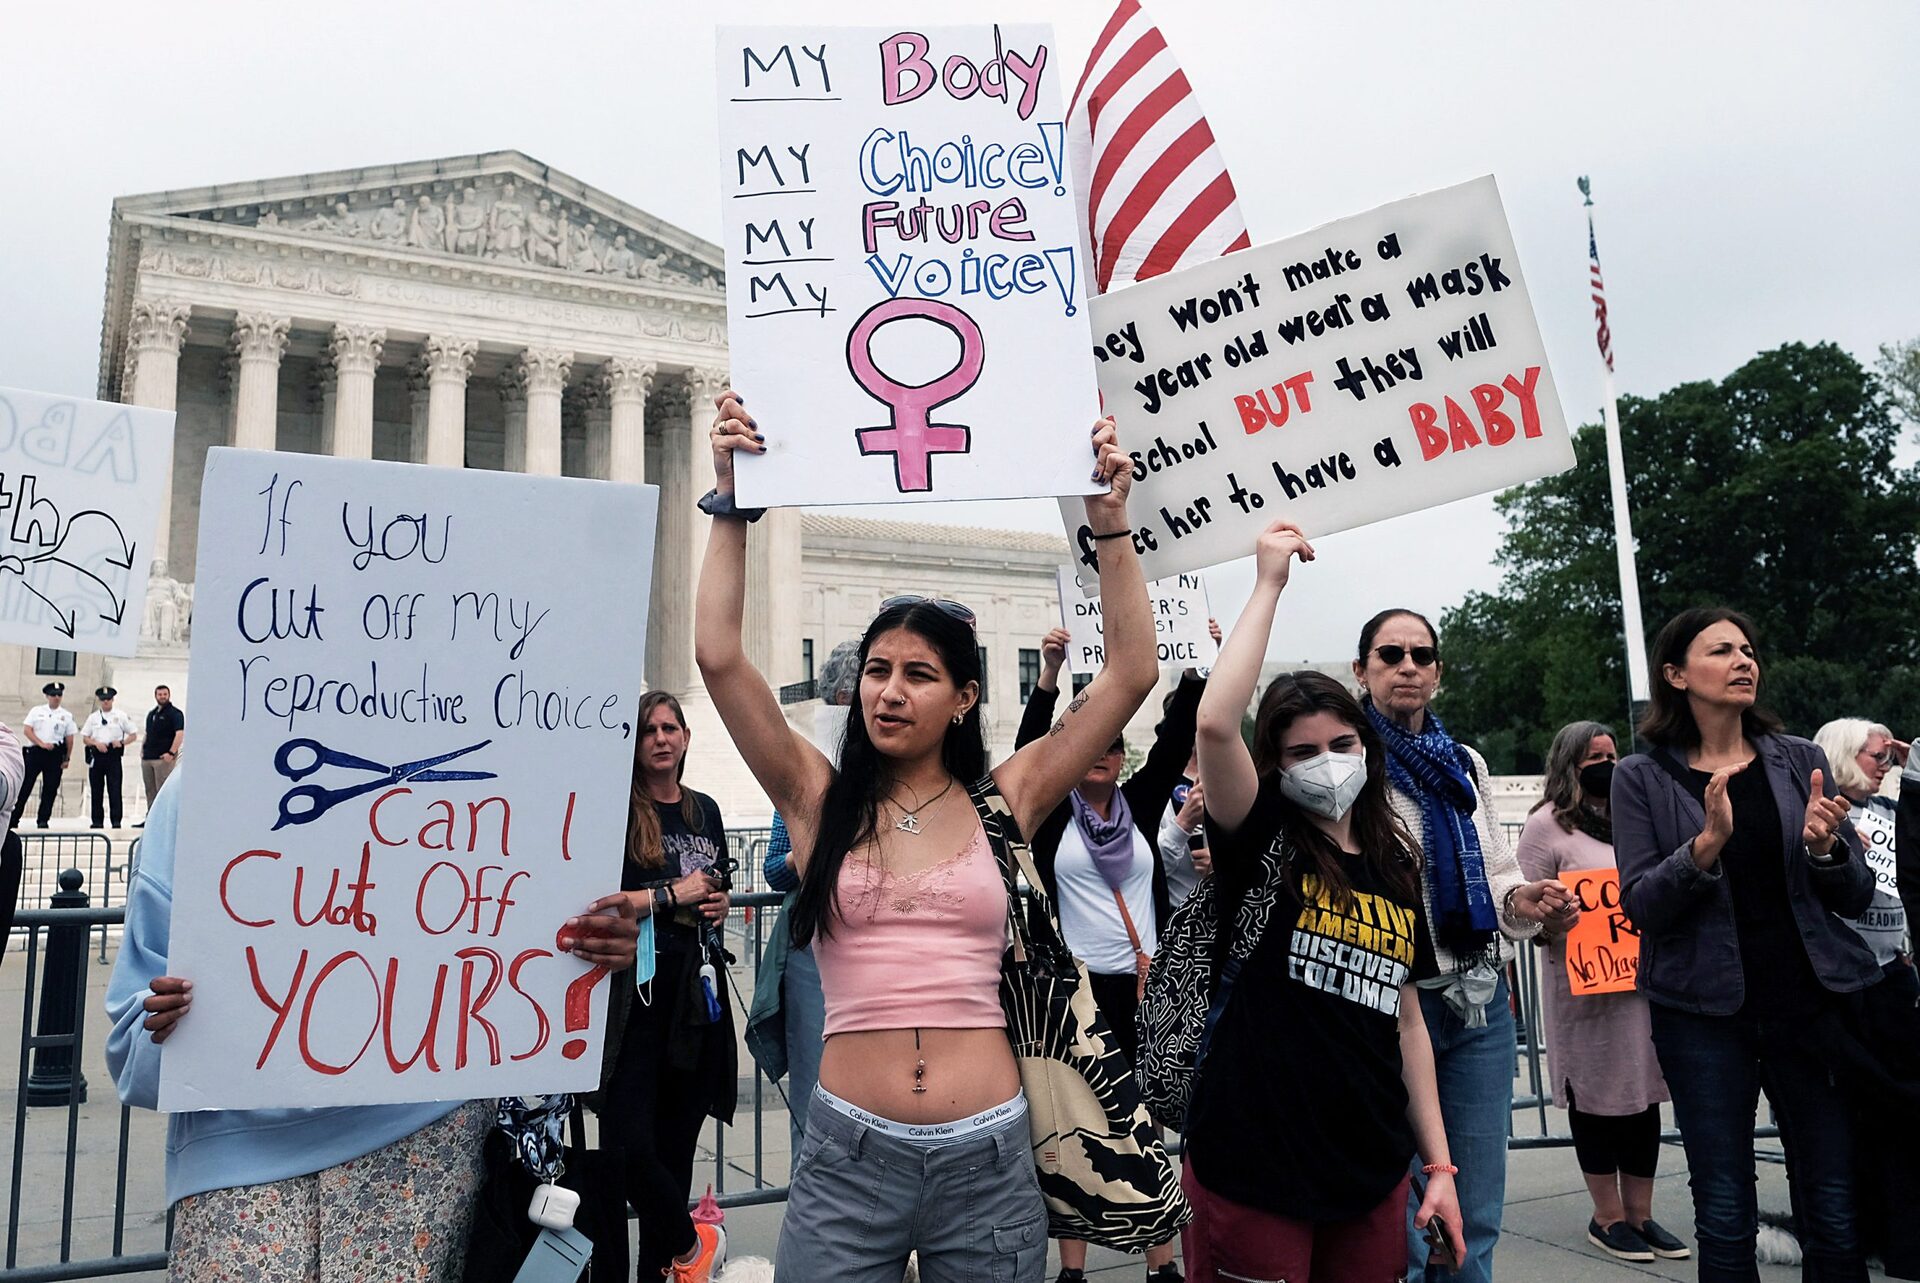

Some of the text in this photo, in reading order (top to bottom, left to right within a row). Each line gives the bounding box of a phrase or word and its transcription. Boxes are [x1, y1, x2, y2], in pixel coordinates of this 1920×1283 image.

[742, 23, 1048, 121] MY Body
[737, 121, 1066, 197] MY Choice!
[745, 197, 1037, 257] MY Future
[1168, 272, 1262, 333] won't
[1282, 247, 1363, 293] make
[1377, 232, 1401, 262] a
[1134, 354, 1213, 415] year
[1223, 329, 1270, 369] old
[1277, 292, 1354, 346] wear
[1360, 292, 1391, 322] a
[1406, 252, 1512, 310] mask
[1130, 312, 1497, 483] school BUT they will
[1076, 366, 1545, 576] fce her to have a BABY
[237, 576, 326, 644] Cut
[238, 655, 467, 733] reproductive
[561, 791, 577, 861] I
[1287, 954, 1401, 1019] COLUMB
[1569, 942, 1597, 983] No
[848, 1108, 889, 1131] Calvin Klein
[908, 1126, 955, 1137] Calvin Klein
[972, 1107, 1013, 1127] Calvin Klein
